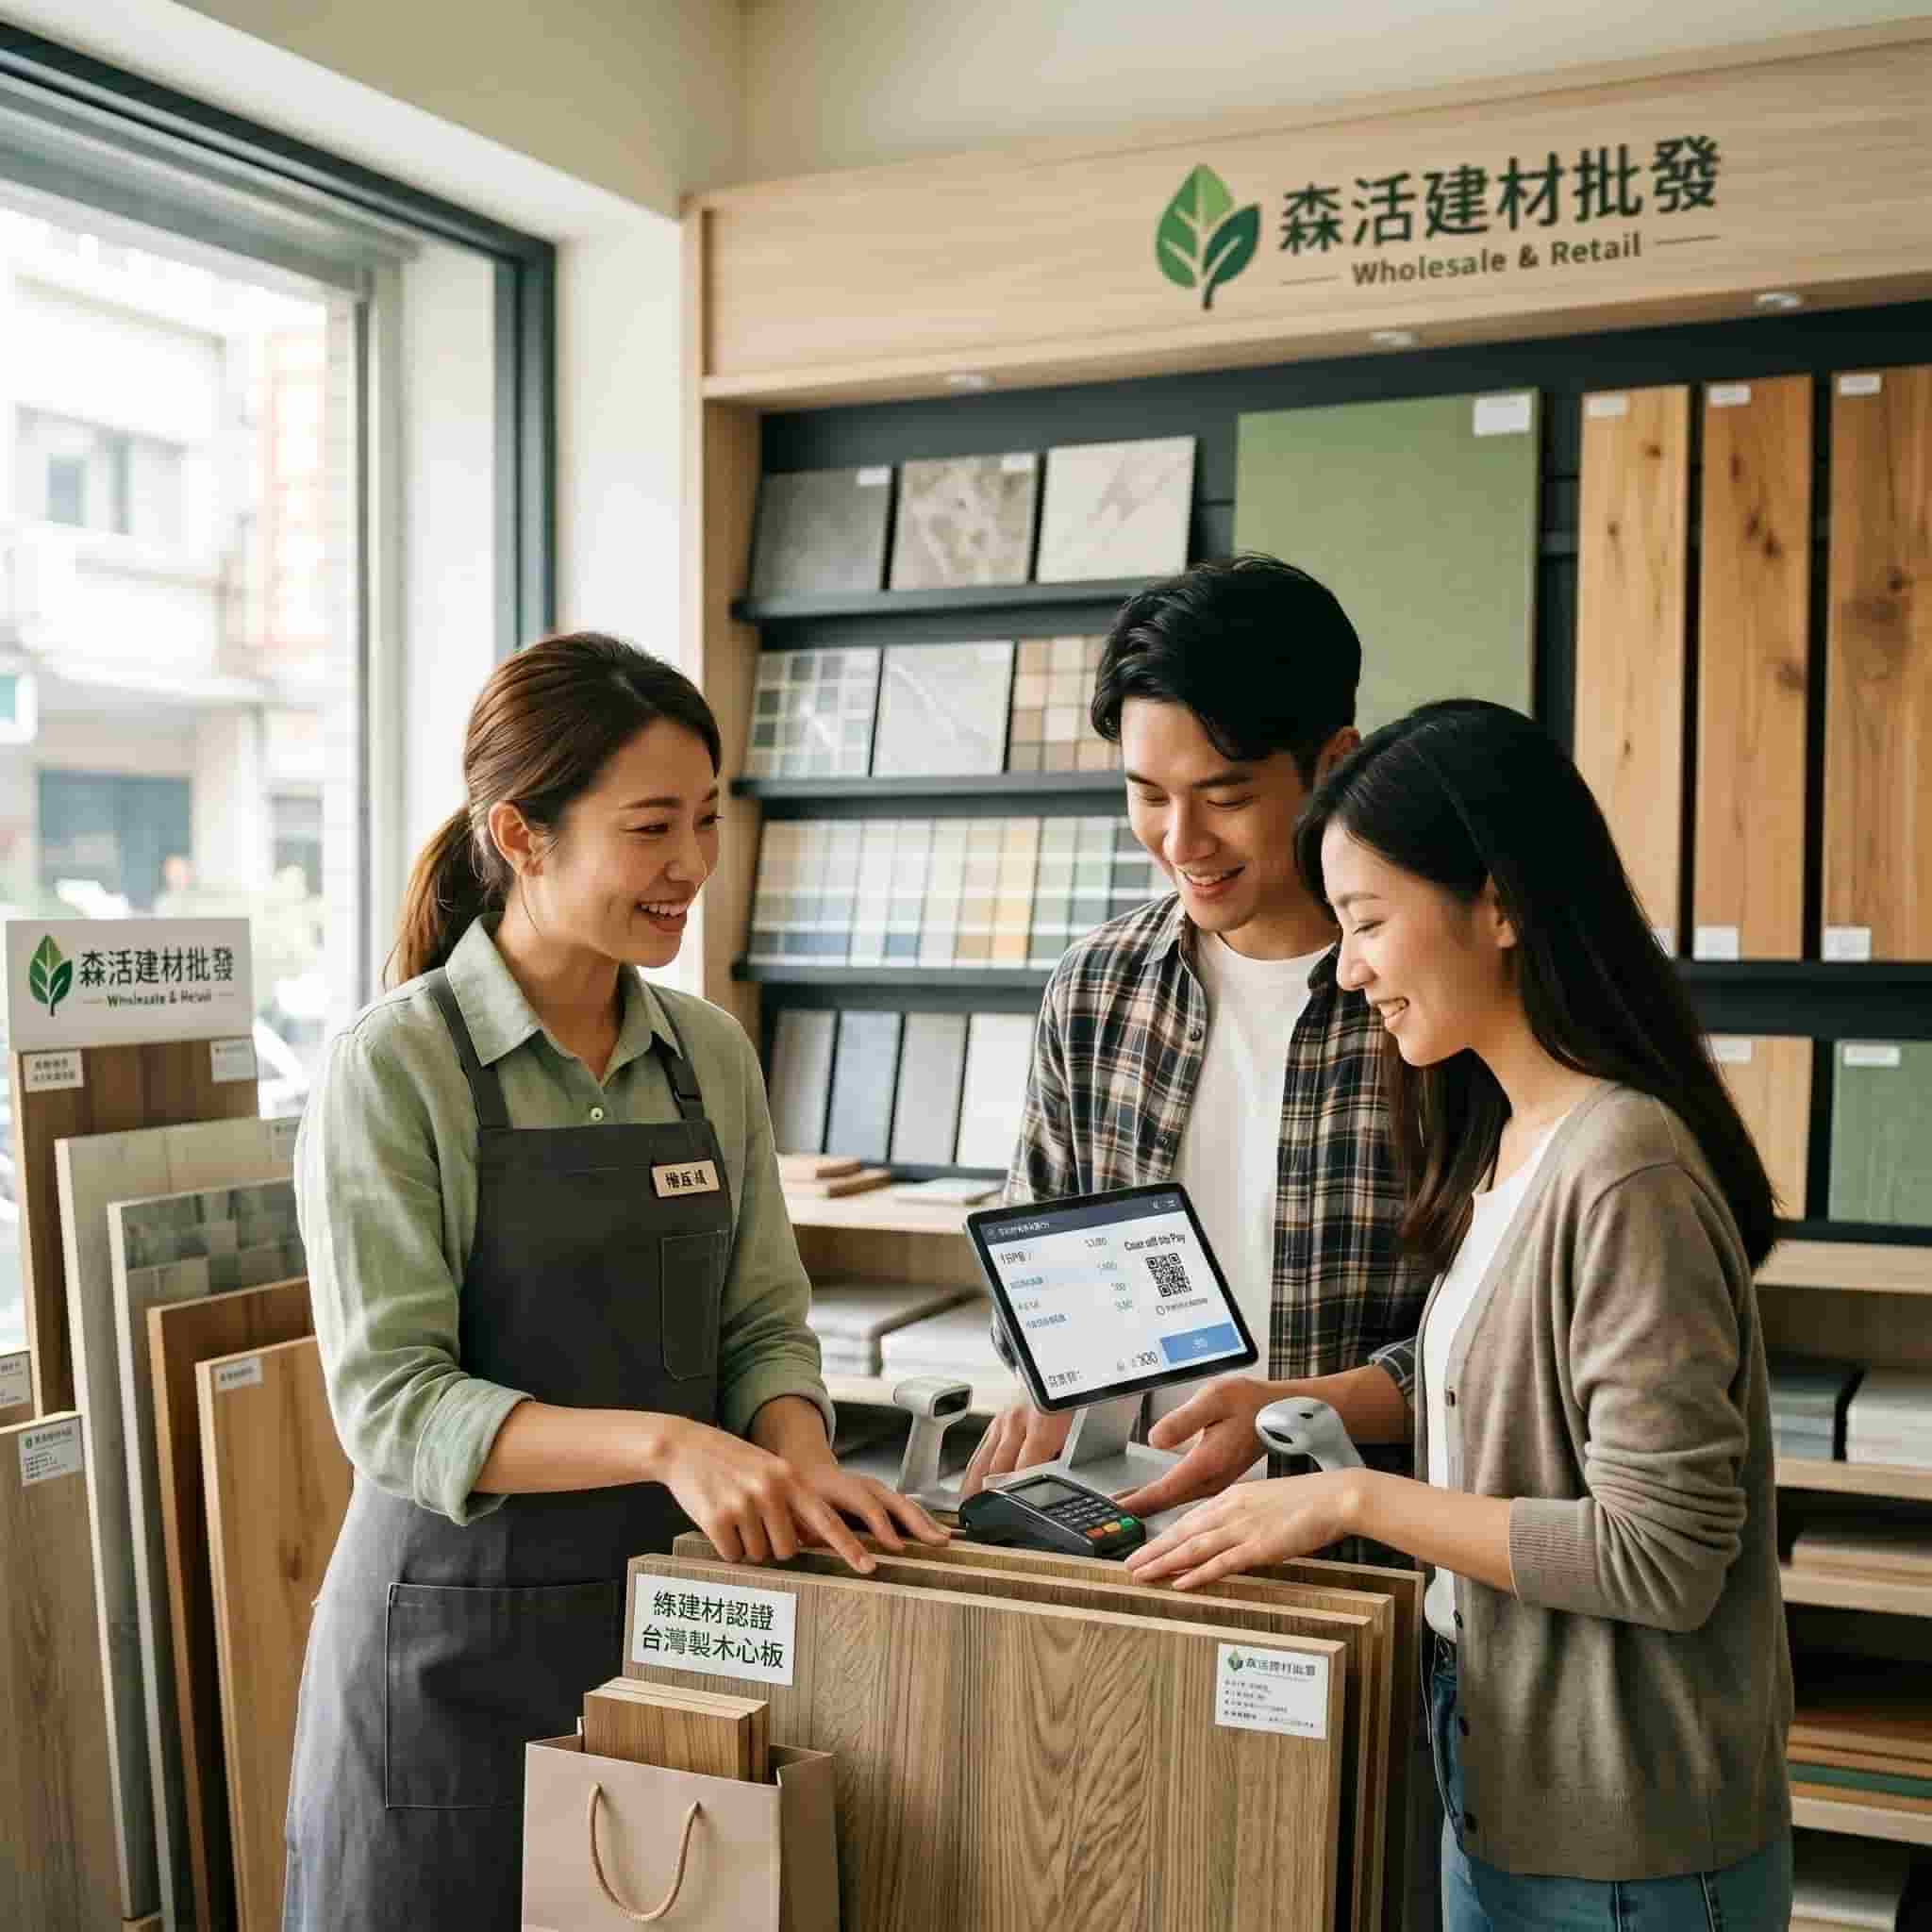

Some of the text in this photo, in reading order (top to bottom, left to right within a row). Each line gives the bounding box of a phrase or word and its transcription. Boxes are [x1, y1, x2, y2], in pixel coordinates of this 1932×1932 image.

[1279, 135, 1721, 256] 森活建材批發
[1352, 231, 1641, 285] Wholesale & Retail
[80, 946, 234, 988] 森活建材批發
[641, 1624, 785, 1669] 台灣製木心板
